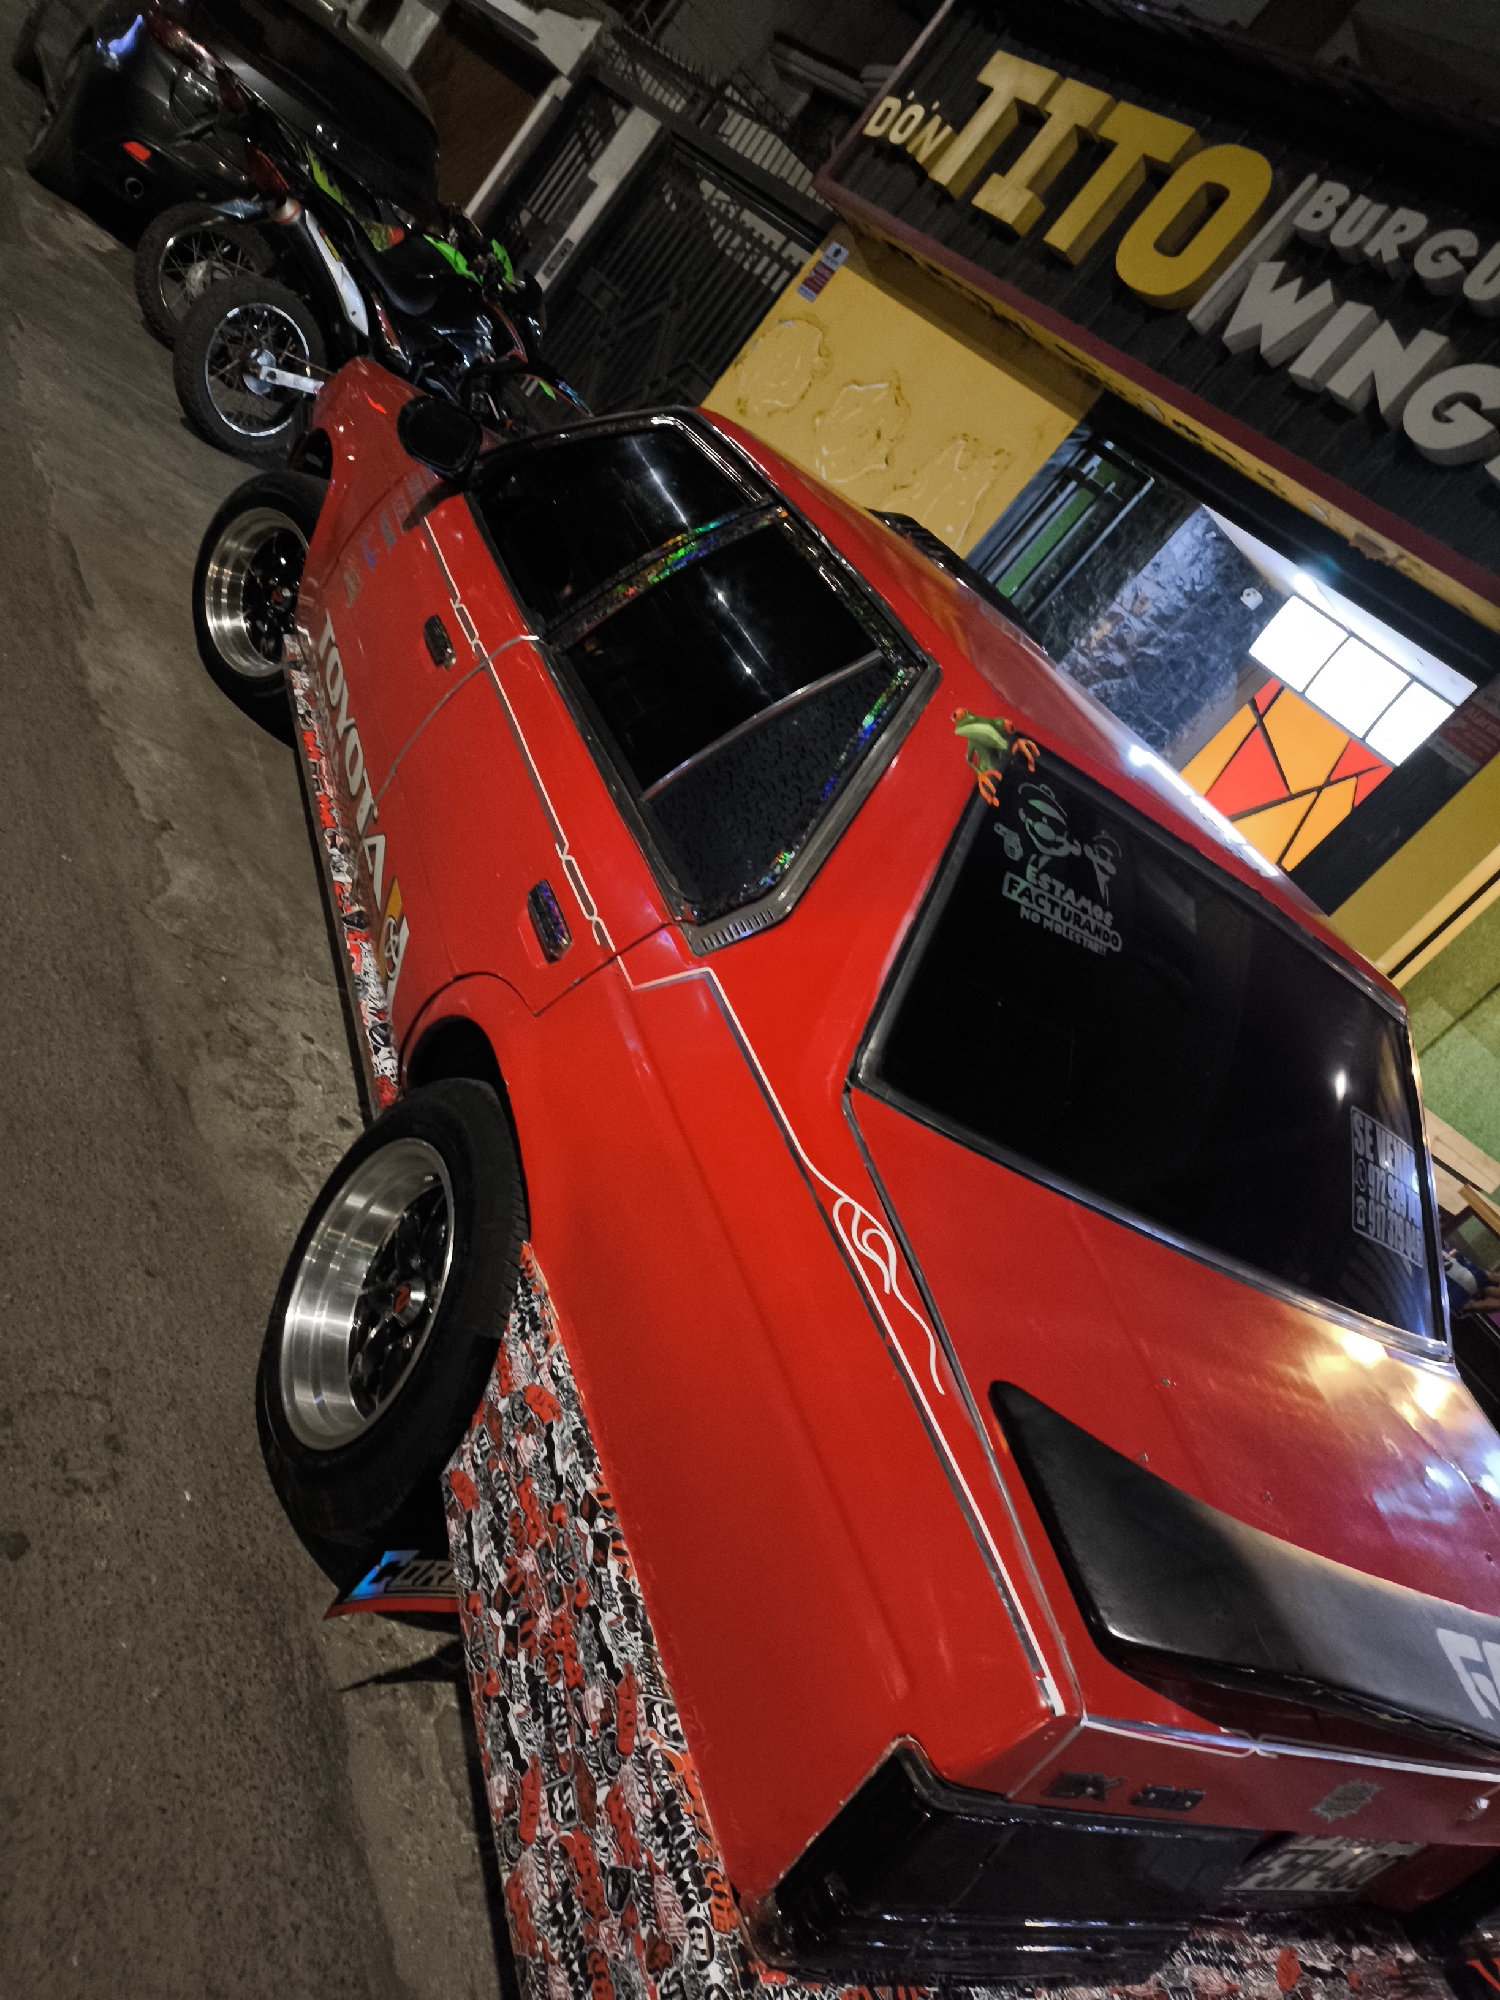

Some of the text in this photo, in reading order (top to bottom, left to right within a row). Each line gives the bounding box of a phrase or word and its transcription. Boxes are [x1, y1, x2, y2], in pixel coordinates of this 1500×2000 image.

[928, 50, 1273, 302] TITO
[1222, 261, 1500, 482] WING
[319, 608, 386, 912] TOYOTA
[1006, 875, 1120, 949] FACTURANDO
[1019, 903, 1041, 924] NO
[1026, 860, 1114, 928] ESTAMOS
[1352, 1111, 1421, 1195] SE VENDE
[349, 1549, 457, 1595] COR
